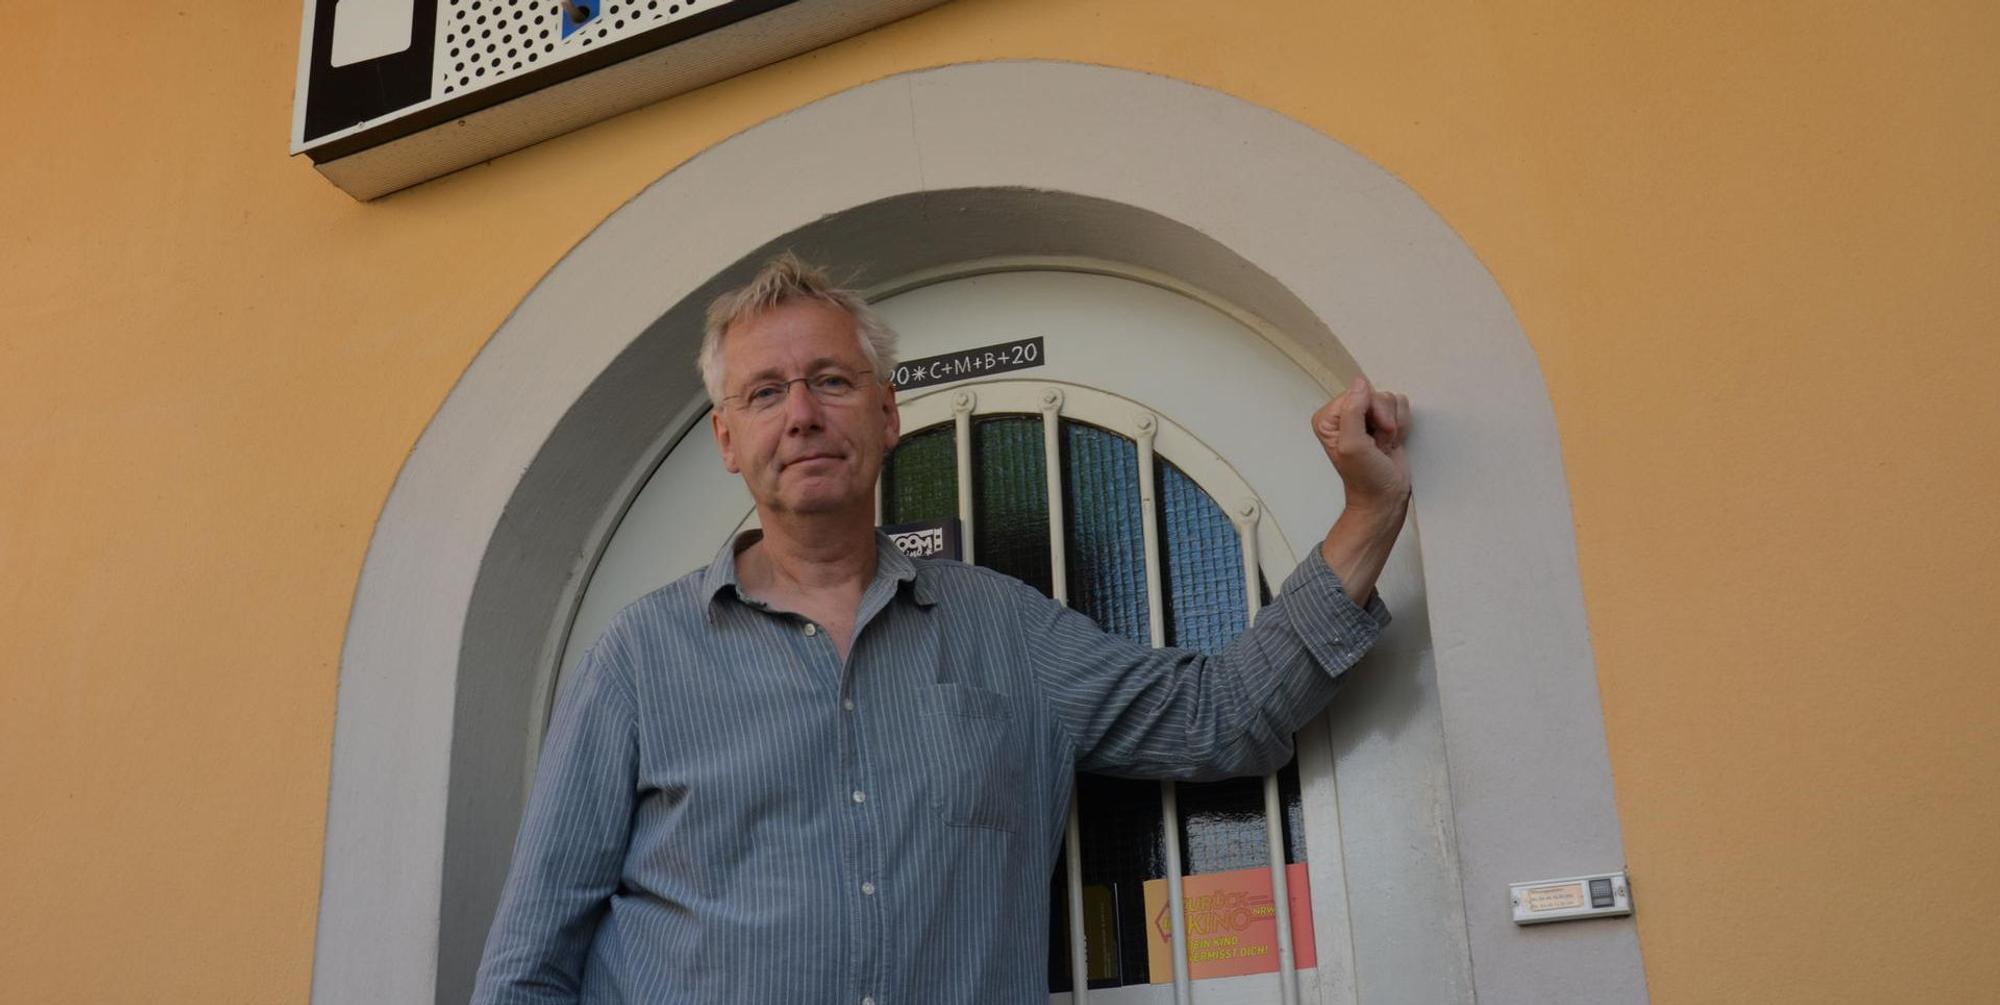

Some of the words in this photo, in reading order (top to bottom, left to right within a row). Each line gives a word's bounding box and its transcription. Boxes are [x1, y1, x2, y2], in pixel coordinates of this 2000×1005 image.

[895, 534, 933, 553] OOM
[1187, 908, 1250, 934] KINO
[1189, 946, 1236, 961] ERMISST
